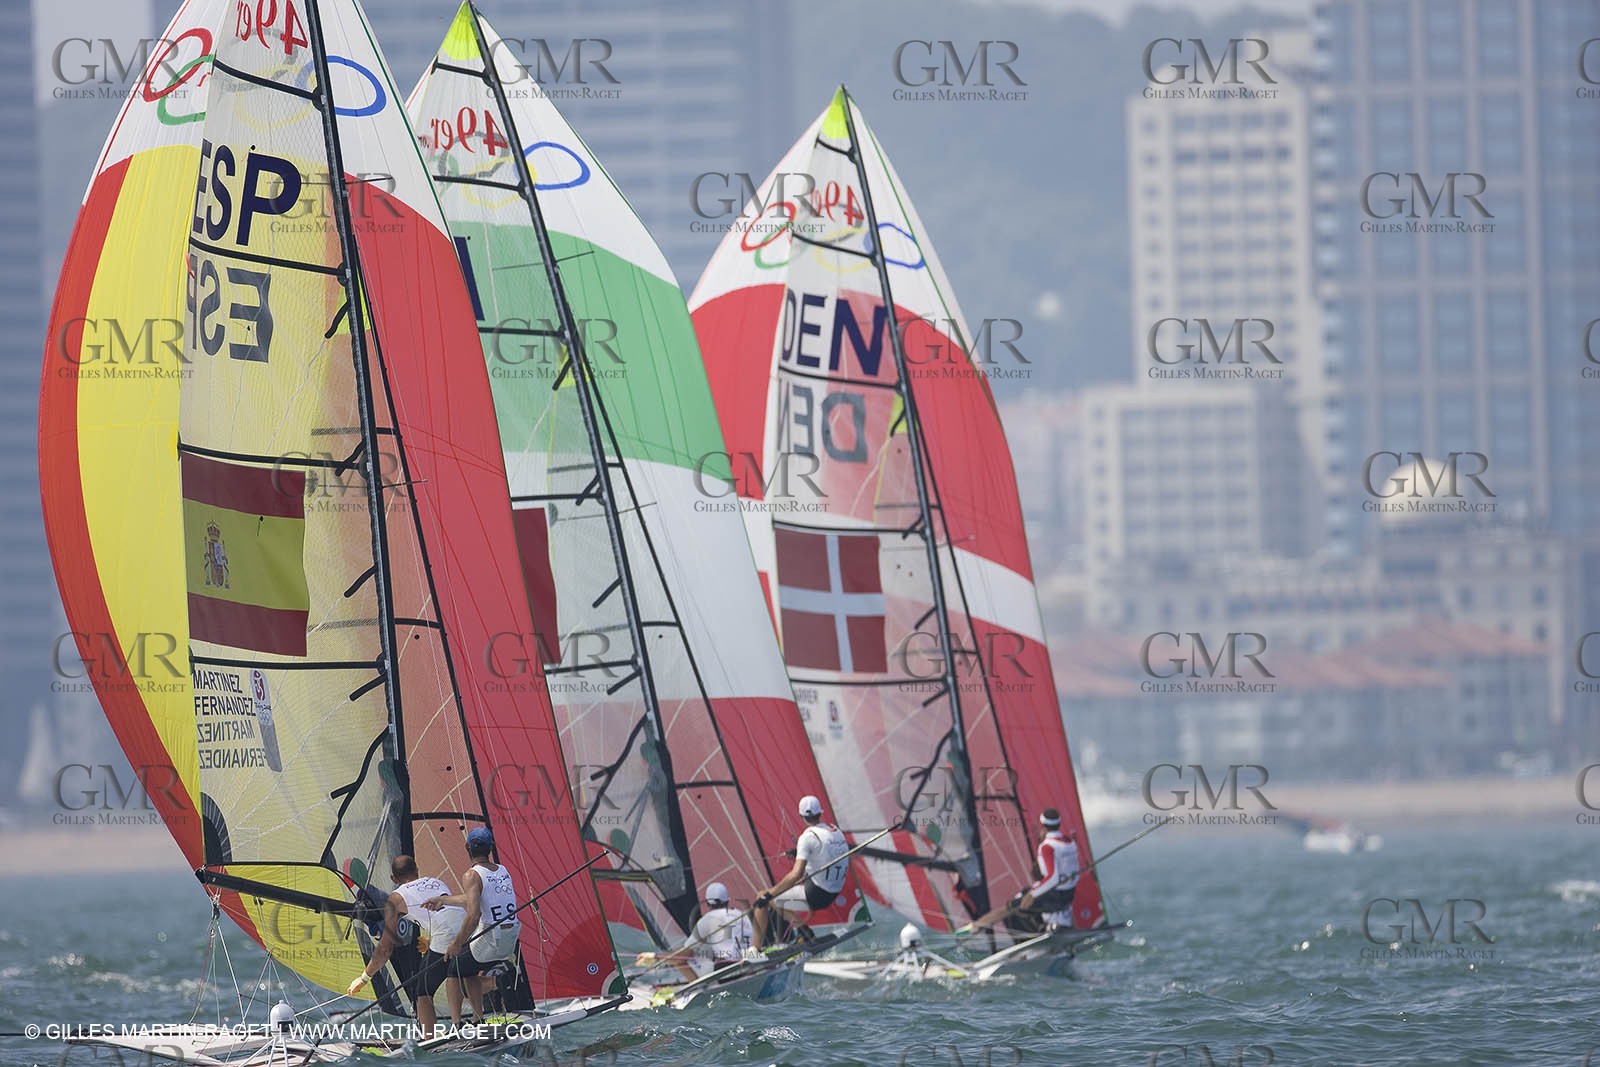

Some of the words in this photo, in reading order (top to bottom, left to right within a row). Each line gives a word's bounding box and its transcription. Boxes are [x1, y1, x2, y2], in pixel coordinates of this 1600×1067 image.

[193, 138, 301, 246] ESP
[782, 288, 888, 376] DEN
[193, 669, 243, 693] MARTINEZ
[194, 696, 256, 716] FERNANDEZ
